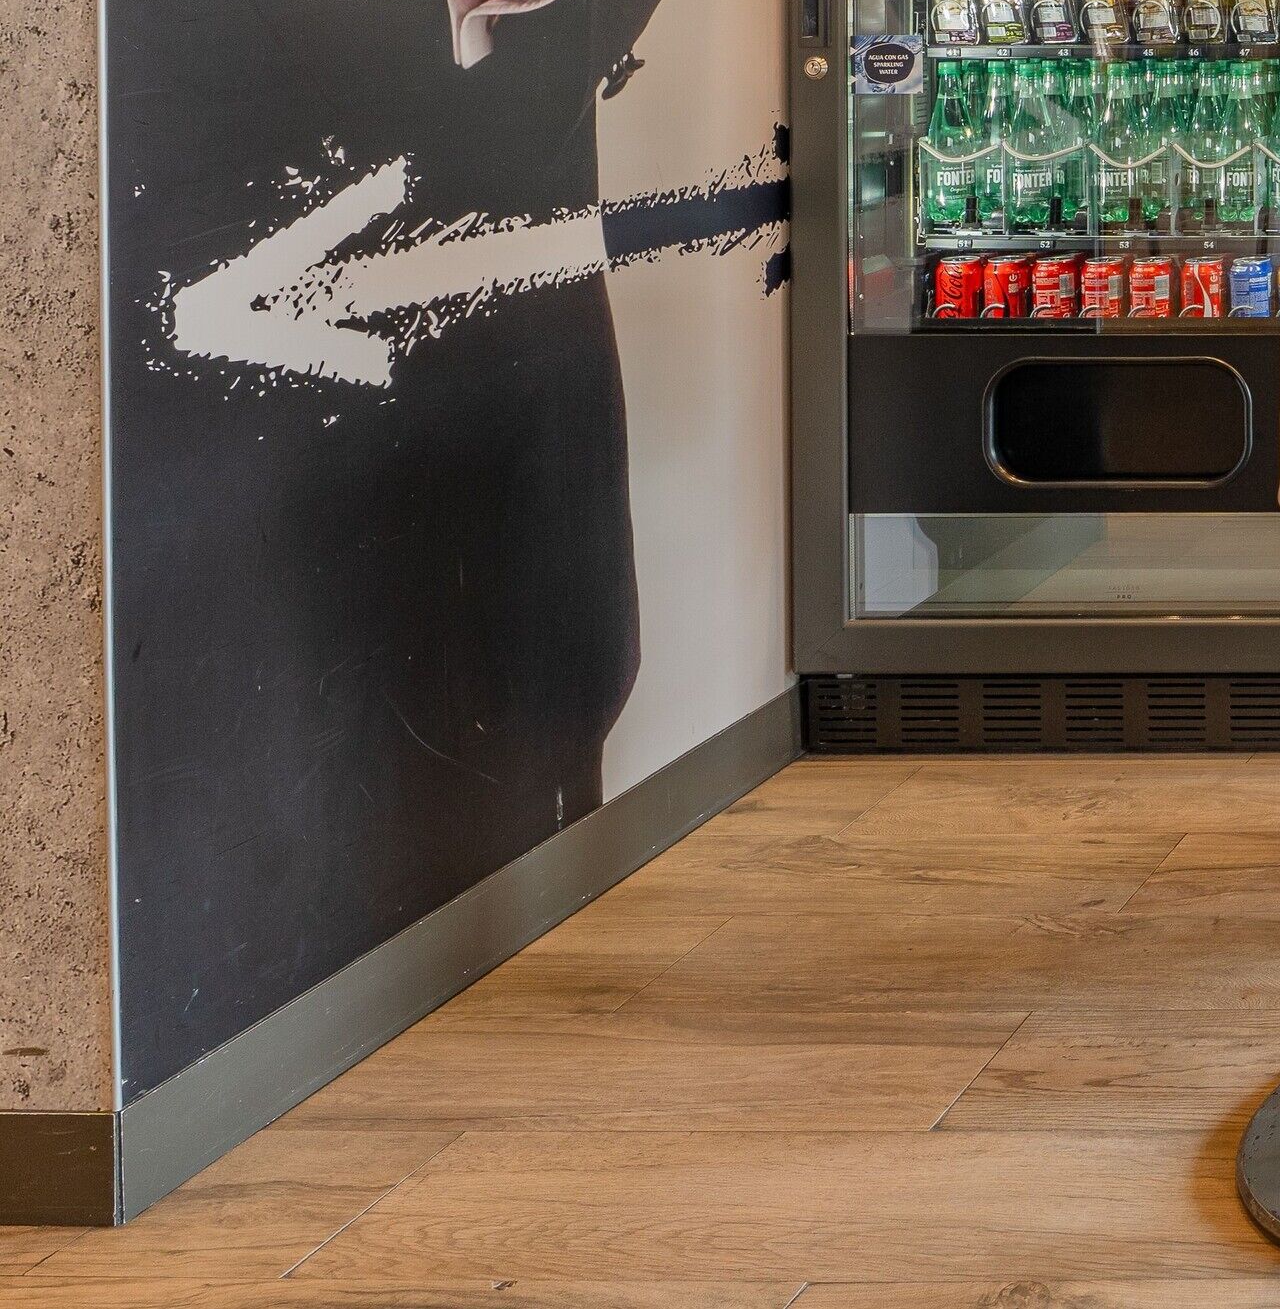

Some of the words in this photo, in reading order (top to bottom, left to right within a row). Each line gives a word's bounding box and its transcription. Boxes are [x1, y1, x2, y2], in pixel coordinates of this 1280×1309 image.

[1142, 48, 1154, 56] 45
[1188, 48, 1200, 56] 46
[1239, 48, 1250, 56] 47
[958, 240, 969, 248] 51
[1119, 241, 1130, 249] 53
[1203, 241, 1214, 249] 54
